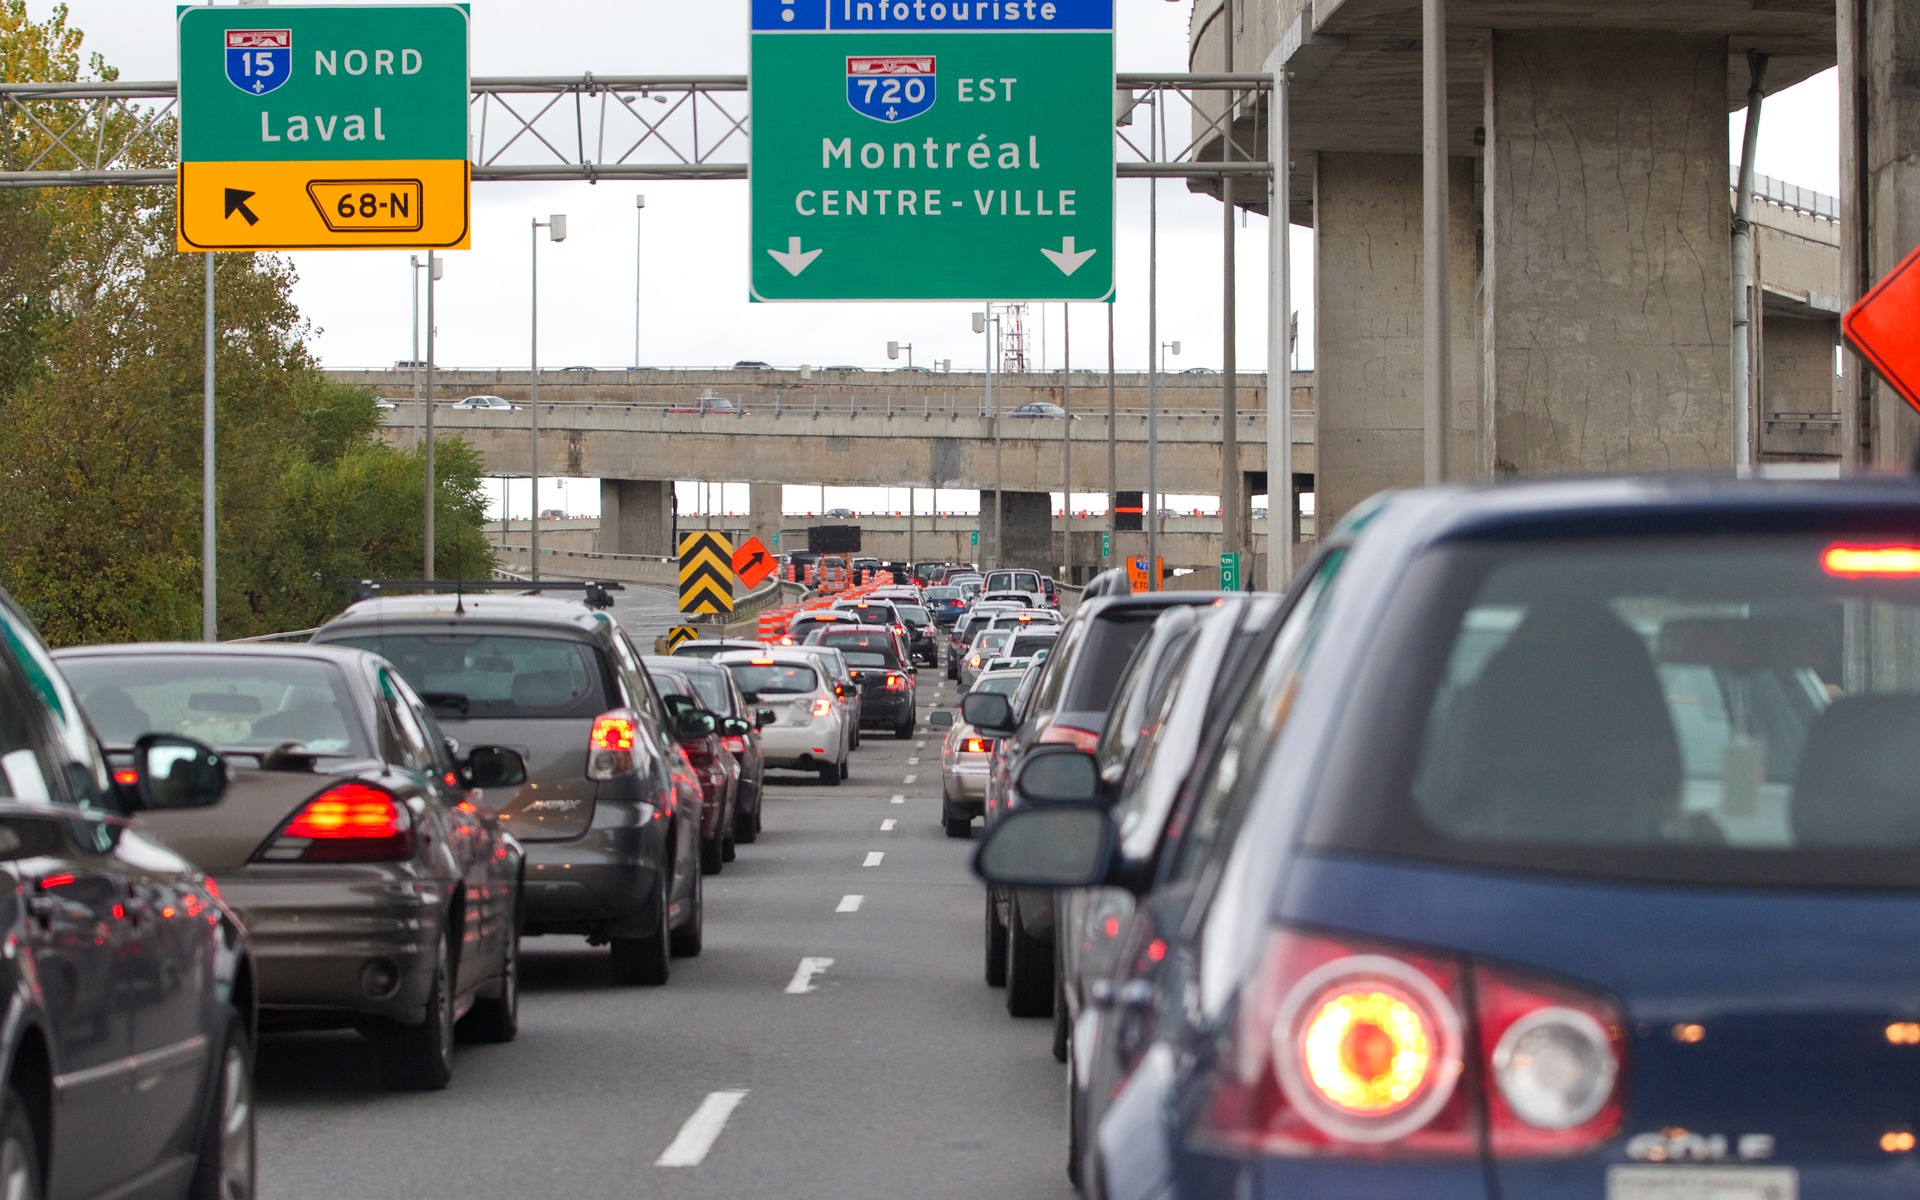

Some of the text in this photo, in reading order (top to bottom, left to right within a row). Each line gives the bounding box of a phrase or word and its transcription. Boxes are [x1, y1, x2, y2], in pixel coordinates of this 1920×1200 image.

[845, 0, 1056, 20] Infotouriste
[243, 49, 421, 76] 15 NORD
[858, 79, 1016, 103] 720 EST
[262, 108, 384, 141] Laval
[823, 134, 1039, 168] Montréal
[338, 193, 408, 217] 68-N
[1223, 570, 1231, 582] 0
